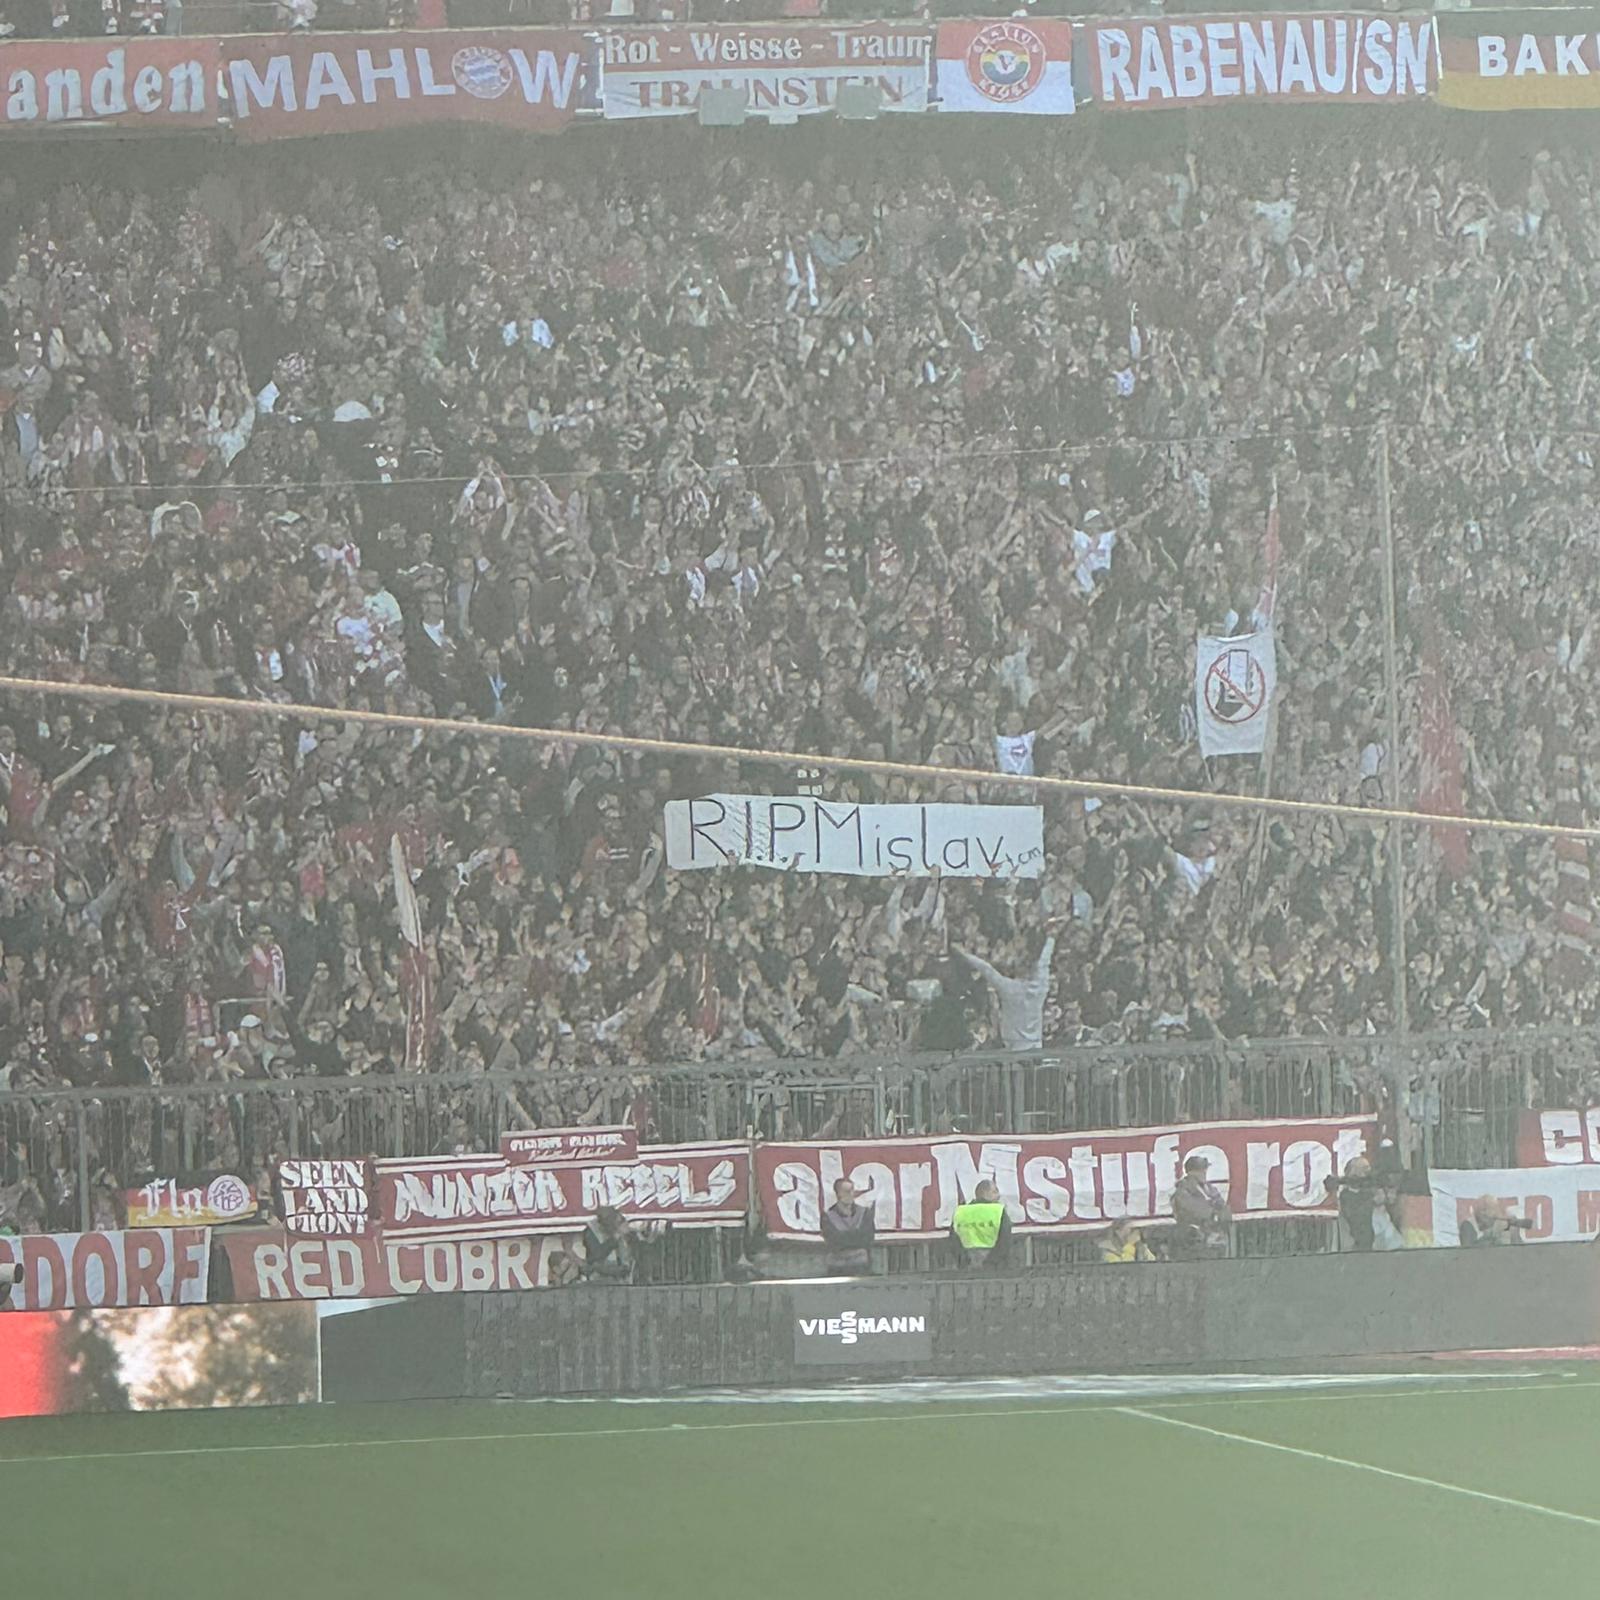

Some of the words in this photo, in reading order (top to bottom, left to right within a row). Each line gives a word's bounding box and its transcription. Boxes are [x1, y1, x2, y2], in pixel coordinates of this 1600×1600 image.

[605, 34, 661, 64] Rot
[690, 31, 802, 64] Weisse
[1477, 33, 1600, 77] BAK
[7, 48, 205, 120] anden
[814, 800, 1004, 871] Mislav
[279, 1161, 366, 1188] SEEN
[581, 1160, 737, 1211] REBELS
[282, 1188, 368, 1215] LAND
[254, 1240, 366, 1299] RED
[799, 1310, 925, 1345] VIESSMANN
